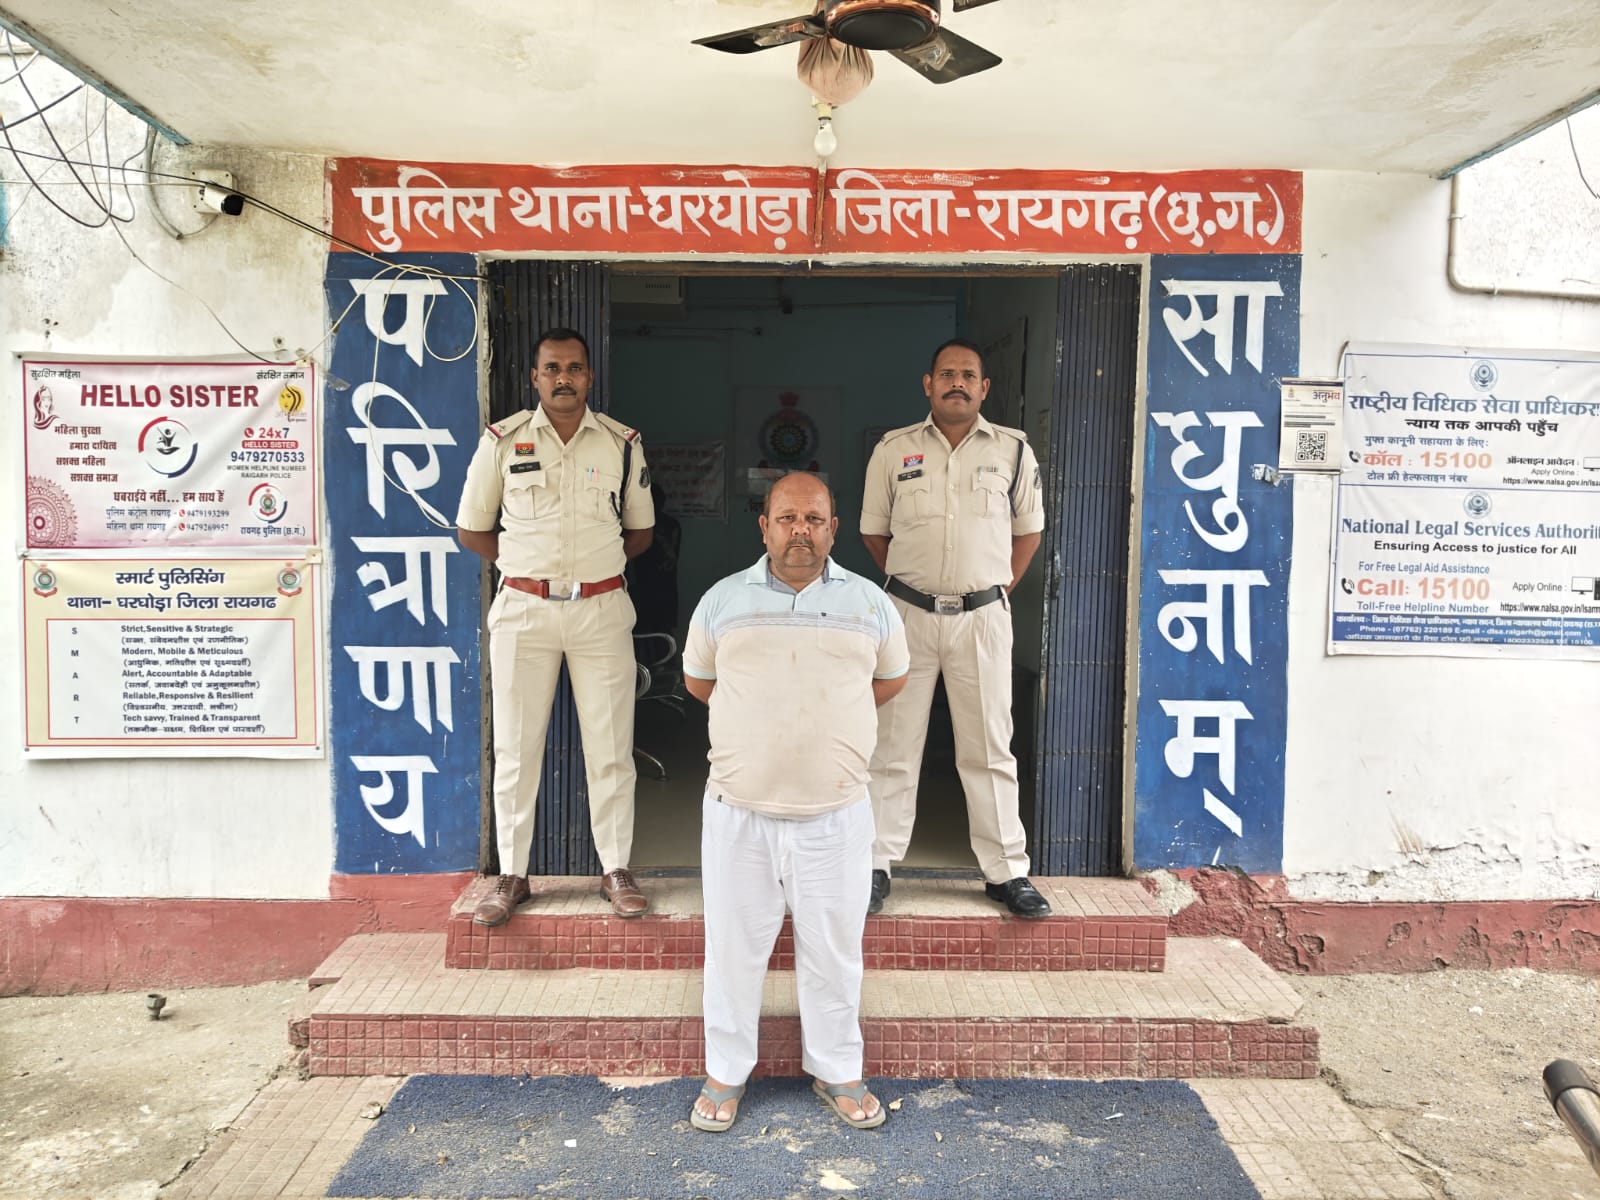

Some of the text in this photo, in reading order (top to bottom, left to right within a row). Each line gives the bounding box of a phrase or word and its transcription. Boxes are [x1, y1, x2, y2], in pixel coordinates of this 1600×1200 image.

[352, 167, 502, 253] पुलिस
[58, 369, 81, 379] महिला
[283, 371, 305, 380] समाज
[80, 385, 259, 408] HELLO SISTER
[1312, 391, 1340, 403] अनुभव
[1348, 391, 1407, 413] राष्ट्रीय
[1413, 392, 1477, 413] विधिक
[1482, 394, 1520, 414] सेवा
[54, 424, 102, 438] महिला सुरक्षा
[258, 427, 290, 439] 24x7
[1405, 418, 1559, 436] न्याय तक आपकी पहुँच
[69, 439, 117, 451] हमारा दायित्व
[270, 441, 296, 449] SISTER
[1364, 436, 1384, 447] मुफ्त
[1388, 435, 1415, 448] कानूनी
[1419, 437, 1452, 446] सहायता
[1455, 436, 1464, 447] के
[56, 455, 106, 466] सशक्त महिला
[231, 451, 305, 462] 9479270533
[1363, 450, 1492, 470] कॉल 15100
[1507, 456, 1575, 466] ऑनलाइन आवेदन
[70, 473, 118, 483] सशक्त समाज
[1367, 470, 1384, 481] टोल
[1388, 470, 1399, 481] फ्री
[1449, 473, 1467, 483] नंबर
[1531, 468, 1575, 476] Apply Online
[114, 489, 146, 502] घबराईये
[183, 492, 196, 502] हम
[199, 492, 215, 502] साथ
[106, 507, 125, 520] पुलिस
[106, 520, 127, 532] महिला
[263, 525, 282, 537] पुलिस
[1341, 518, 1409, 534] National
[1415, 521, 1458, 539] Legal
[1464, 522, 1530, 537] Services
[1374, 540, 1577, 554] Ensuring Access to justice for All
[1359, 561, 1490, 574] For Free Legal Aid Assistance
[116, 568, 225, 590] स्मार्ट पुलिसिंग
[1357, 577, 1490, 600] Call: 15100
[1512, 581, 1563, 592] Apply Online
[117, 593, 171, 612] घरघोड़ा
[177, 592, 218, 609] जिला
[1358, 601, 1489, 614] Toll-Free Helpline Number
[72, 627, 77, 635] S
[195, 625, 234, 634] Strategic
[1455, 626, 1480, 634] E-mail
[193, 636, 204, 644] एवं
[121, 648, 155, 656] Modern,
[158, 647, 186, 655] Mobile
[197, 647, 243, 655] Meticulous
[200, 658, 211, 667] एवं
[72, 672, 79, 680] A
[122, 670, 145, 678] Alert,
[209, 670, 252, 679] Adaptable
[192, 680, 202, 689] एवं
[143, 715, 167, 723] savvy,
[211, 714, 260, 723] Transparent
